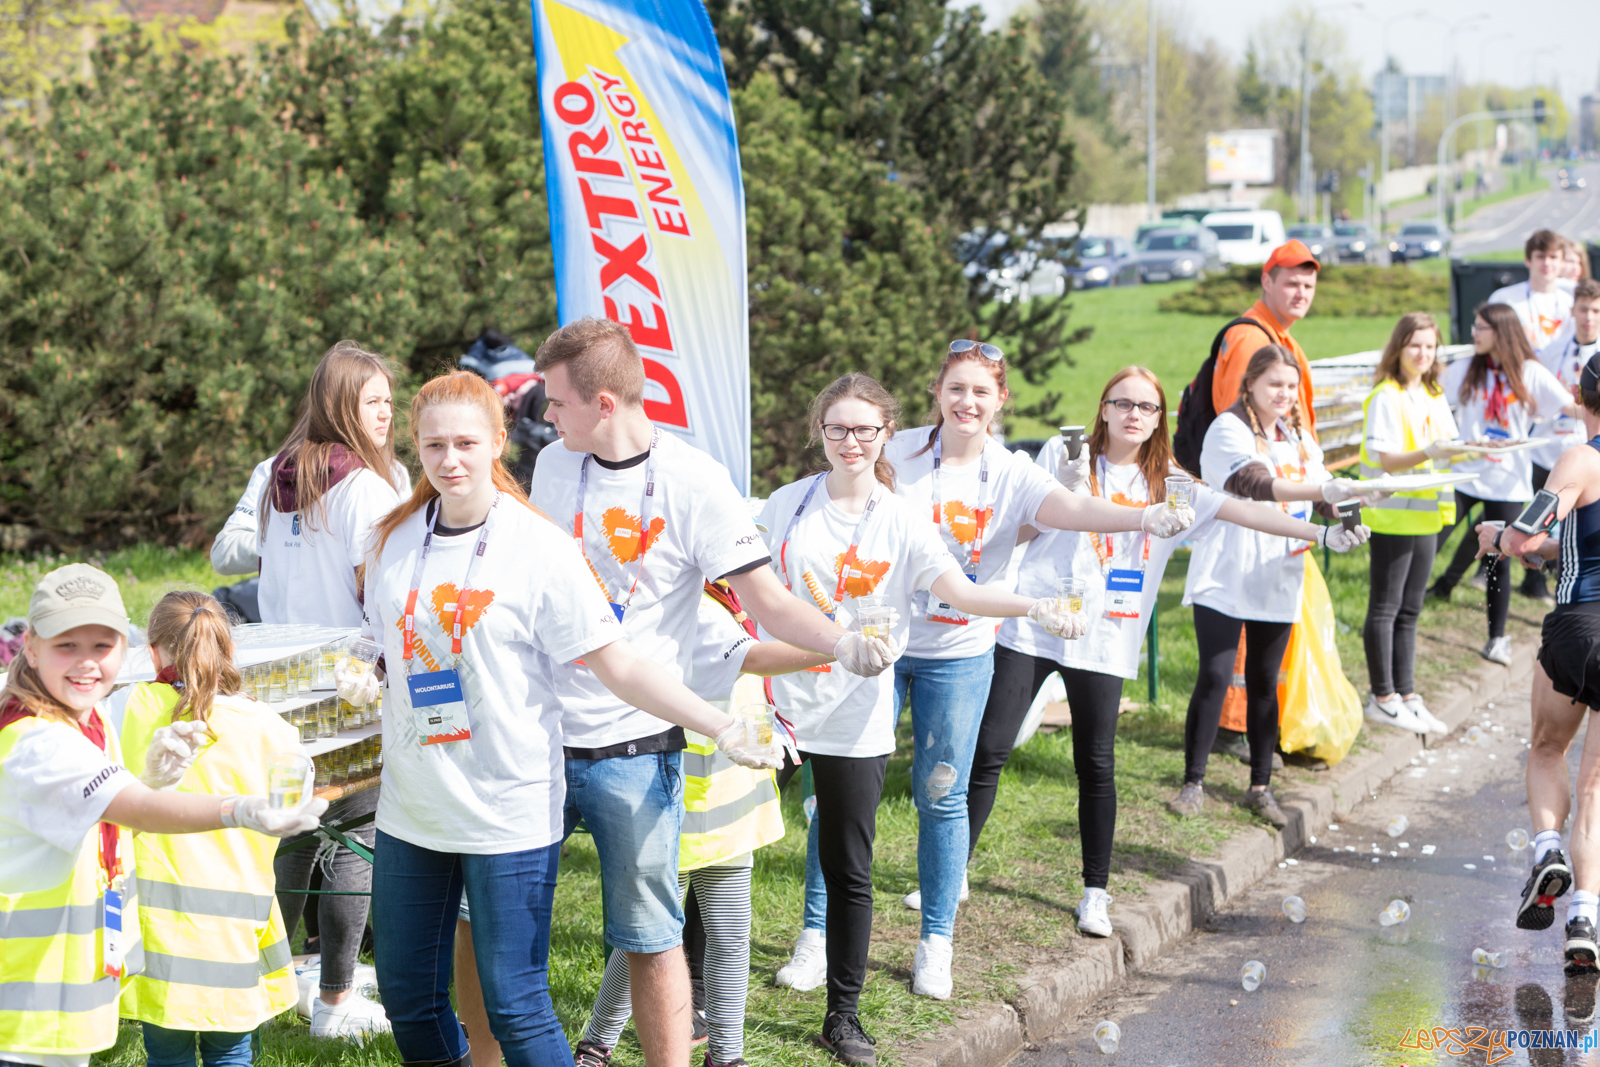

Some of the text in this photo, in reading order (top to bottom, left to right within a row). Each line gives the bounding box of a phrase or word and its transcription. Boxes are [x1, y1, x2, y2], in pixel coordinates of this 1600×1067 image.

[592, 70, 692, 237] ENERGY
[553, 81, 689, 430] DEXTRO
[414, 682, 456, 694] WOLONTARIUSZ
